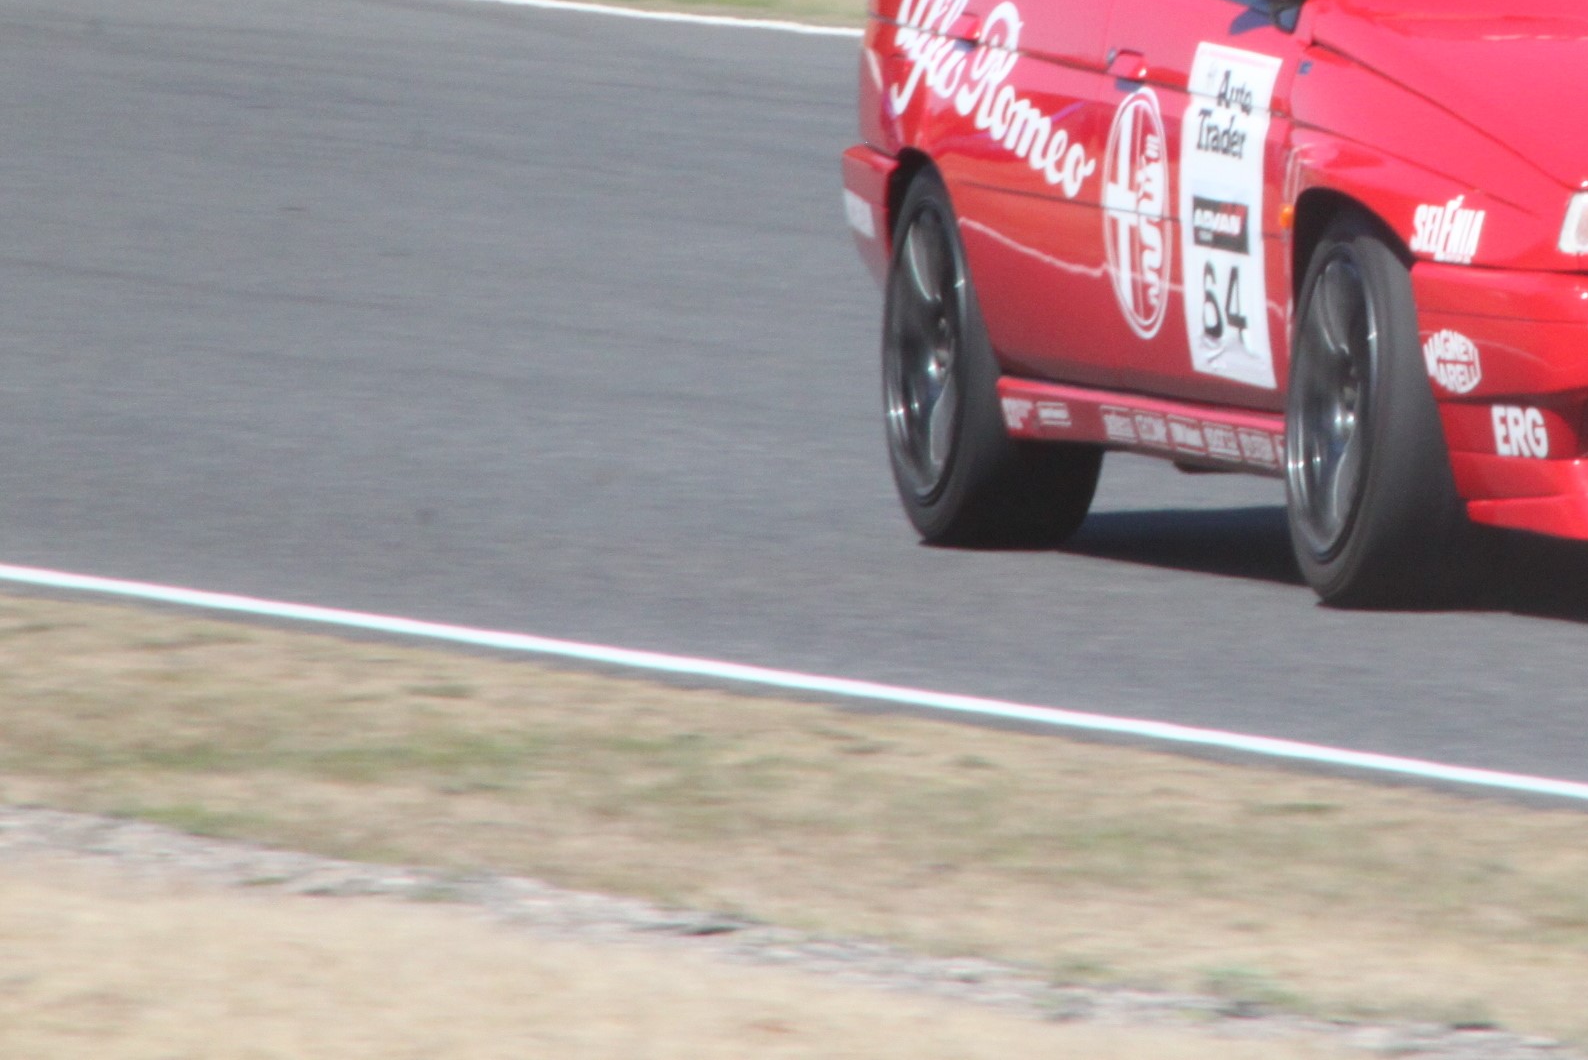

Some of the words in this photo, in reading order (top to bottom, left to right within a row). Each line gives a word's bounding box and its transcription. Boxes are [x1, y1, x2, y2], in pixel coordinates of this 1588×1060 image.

[955, 0, 1096, 198] Romeo
[1217, 70, 1253, 116] Auto
[1196, 108, 1247, 160] Trader
[1202, 260, 1248, 345] 64
[1491, 405, 1549, 459] ERG
